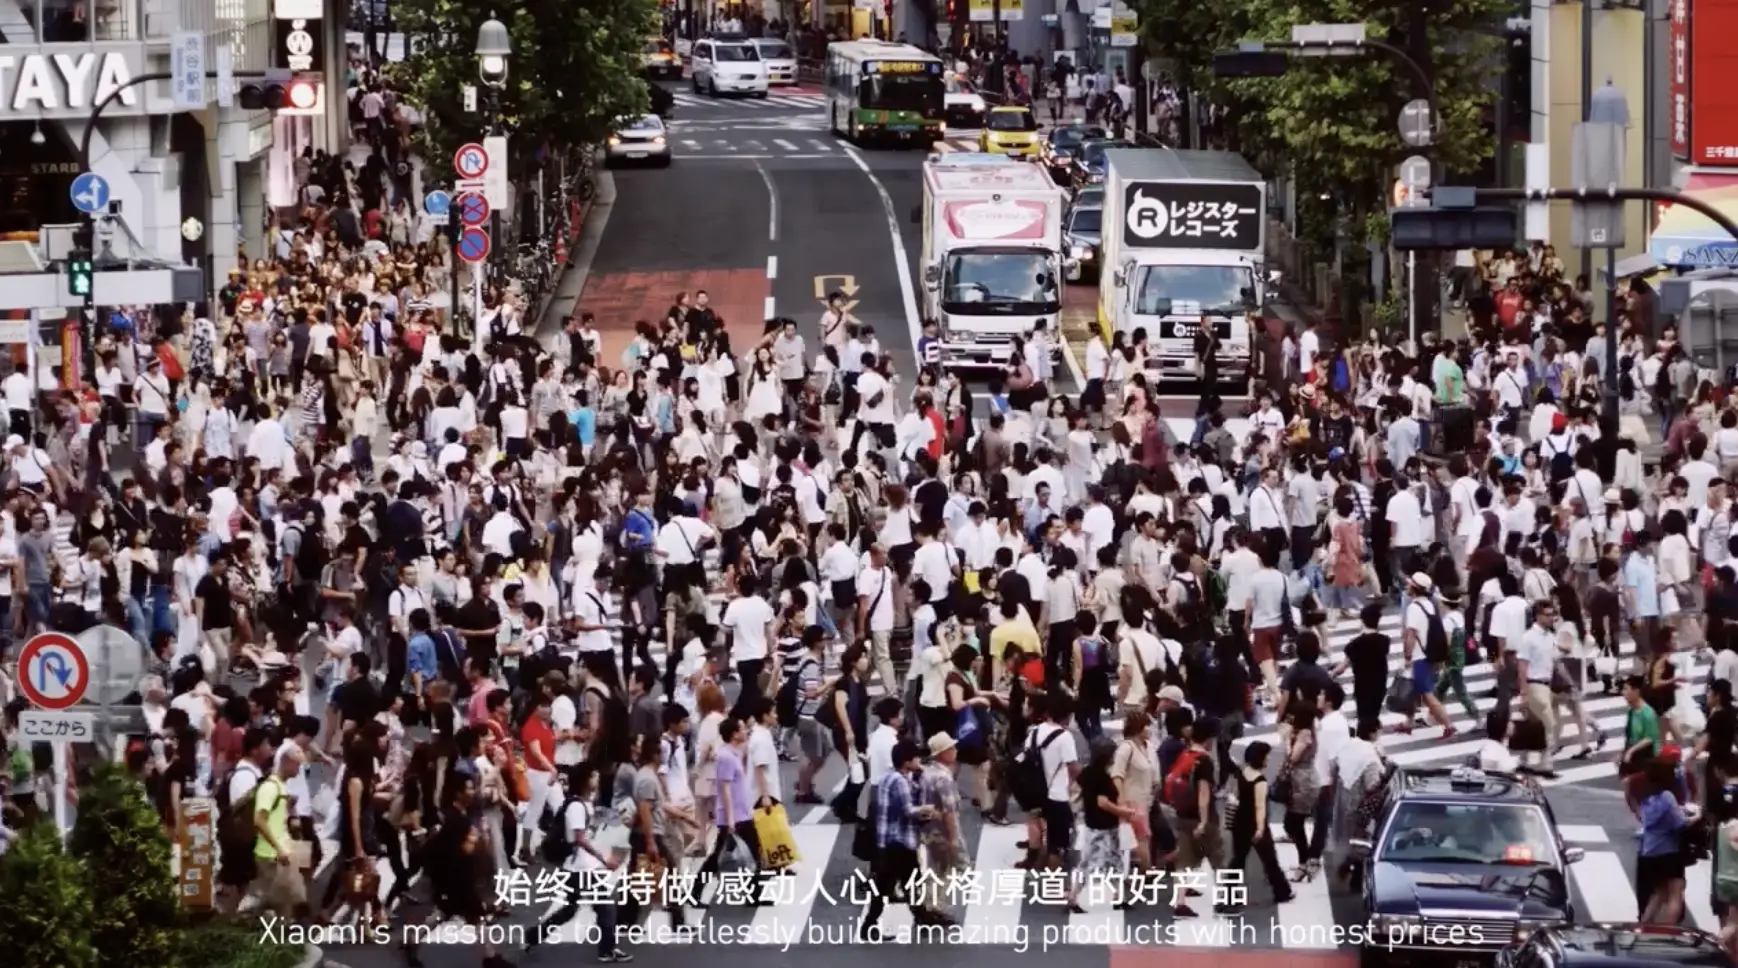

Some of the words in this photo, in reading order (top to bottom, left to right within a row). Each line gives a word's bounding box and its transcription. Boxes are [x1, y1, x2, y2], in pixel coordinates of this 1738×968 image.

[1170, 201, 1257, 220] レジスター
[1170, 220, 1239, 238] レコーズ
[24, 719, 87, 737] ここから
